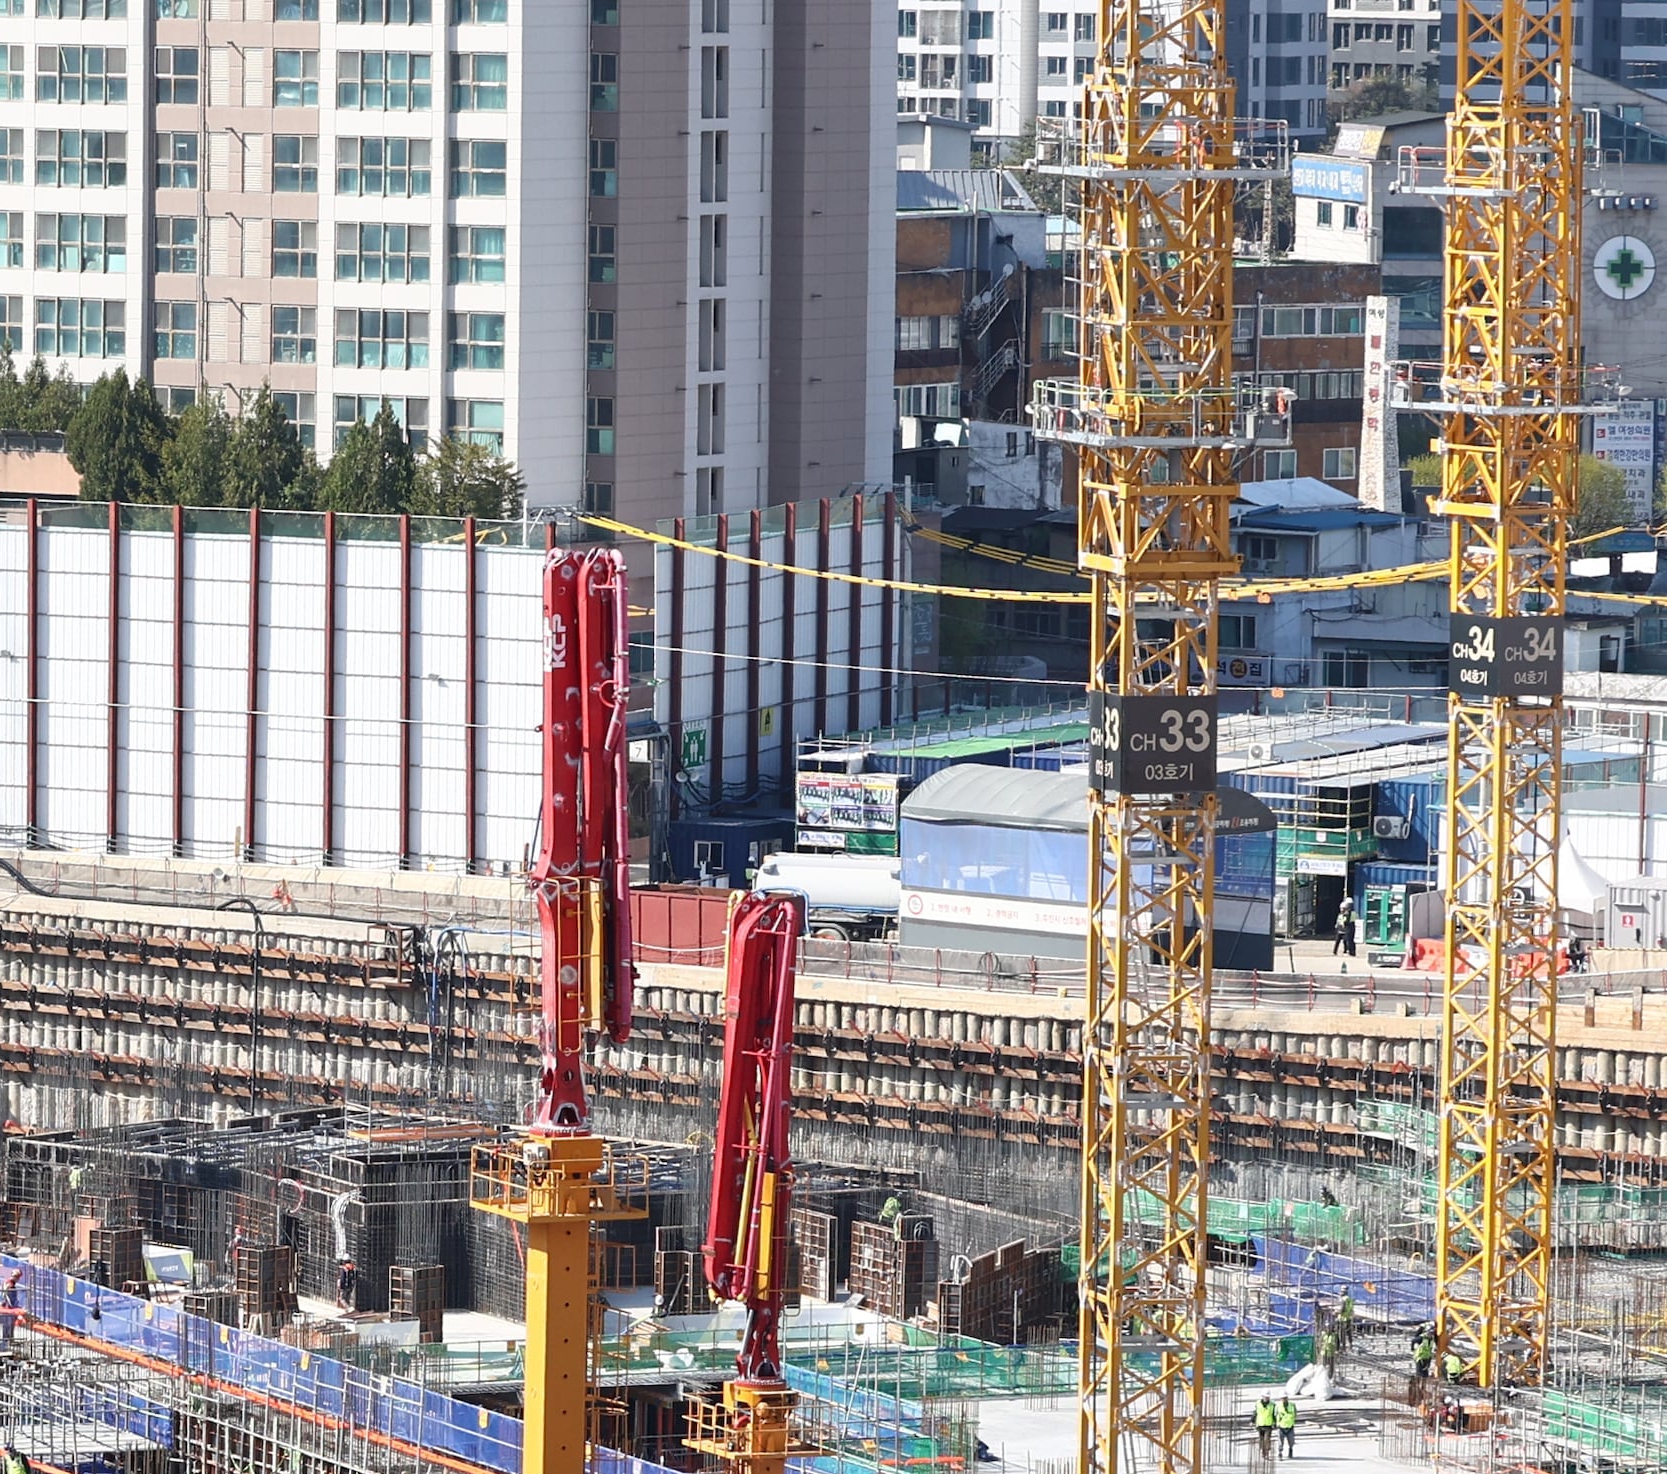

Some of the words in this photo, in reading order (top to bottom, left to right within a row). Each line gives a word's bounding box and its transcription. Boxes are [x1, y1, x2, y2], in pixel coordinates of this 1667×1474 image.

[552, 613, 566, 668] KCP
[1452, 625, 1495, 663] CH34
[1504, 626, 1556, 662] CH34
[1460, 668, 1488, 686] 04호기
[1514, 669, 1547, 685] 04호기
[1130, 709, 1211, 753] CH33
[1145, 762, 1194, 781] 03호기
